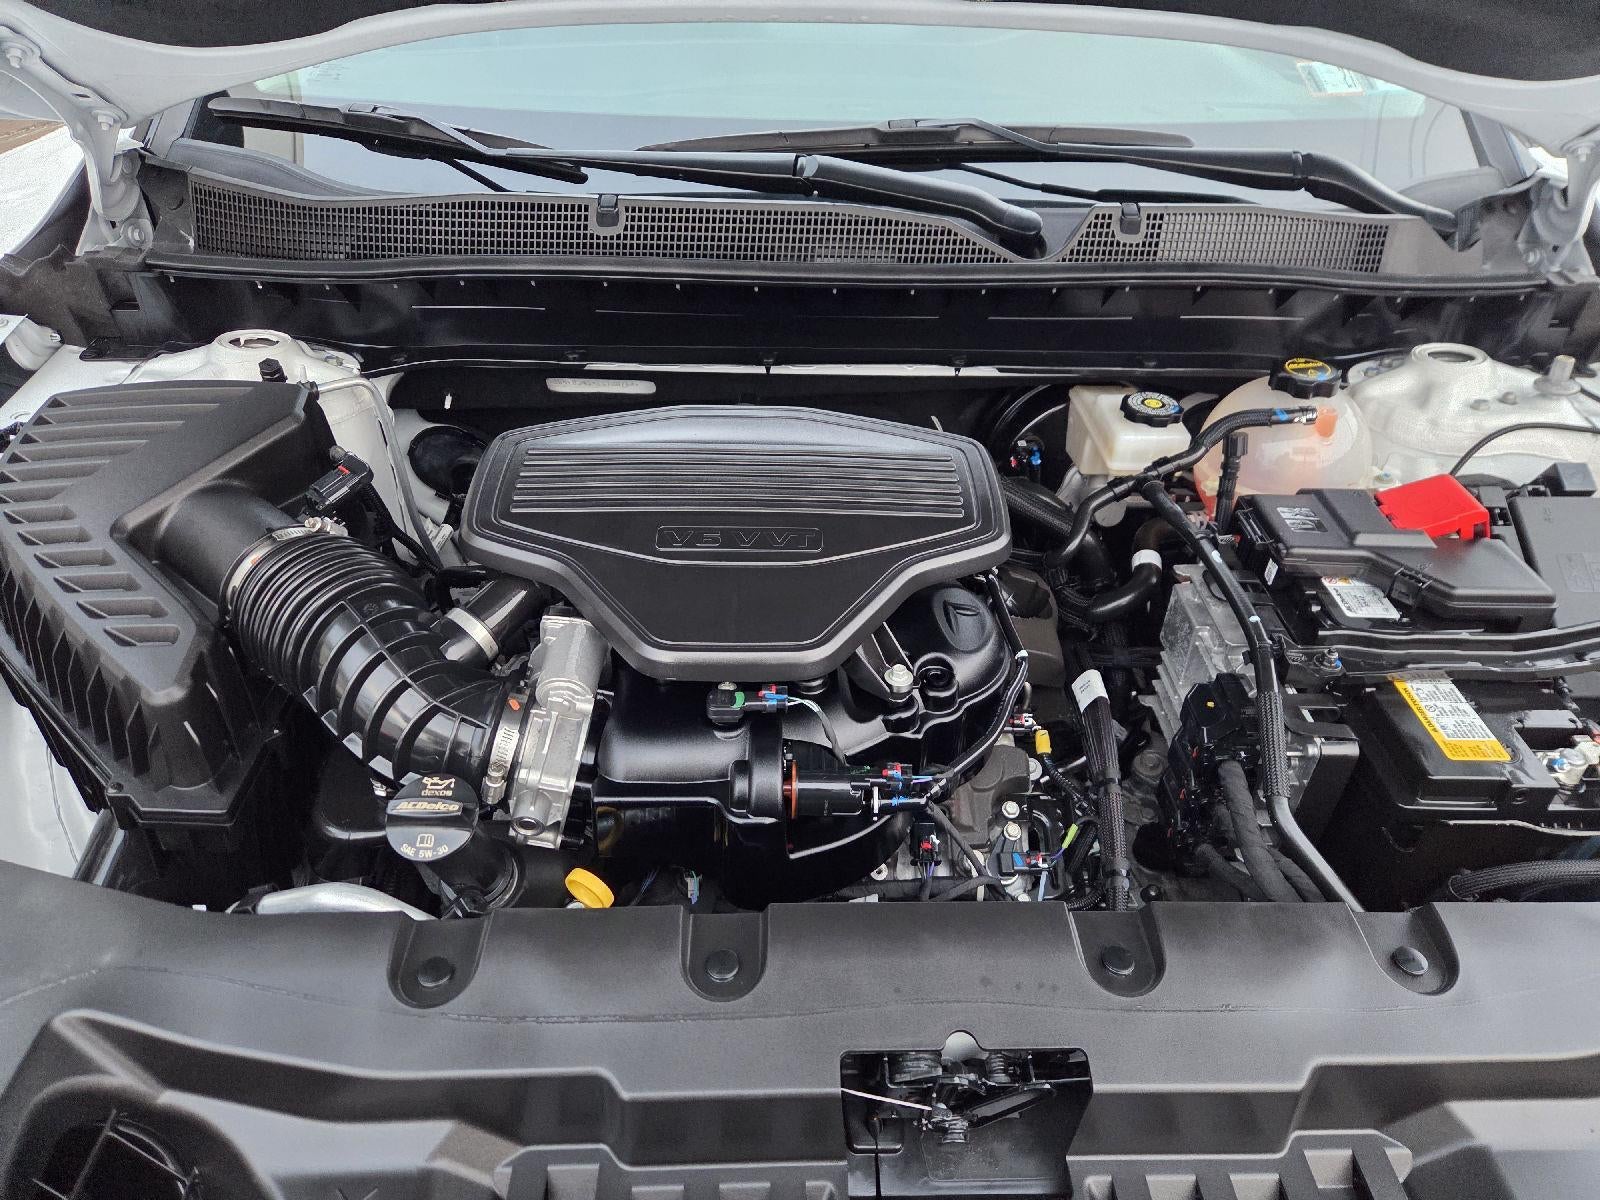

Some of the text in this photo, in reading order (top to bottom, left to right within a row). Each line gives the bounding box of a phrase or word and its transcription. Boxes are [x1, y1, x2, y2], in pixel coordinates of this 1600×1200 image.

[663, 530, 816, 548] V6 VVT
[395, 801, 459, 811] ACDelco
[400, 843, 449, 858] SAE 5W-30
